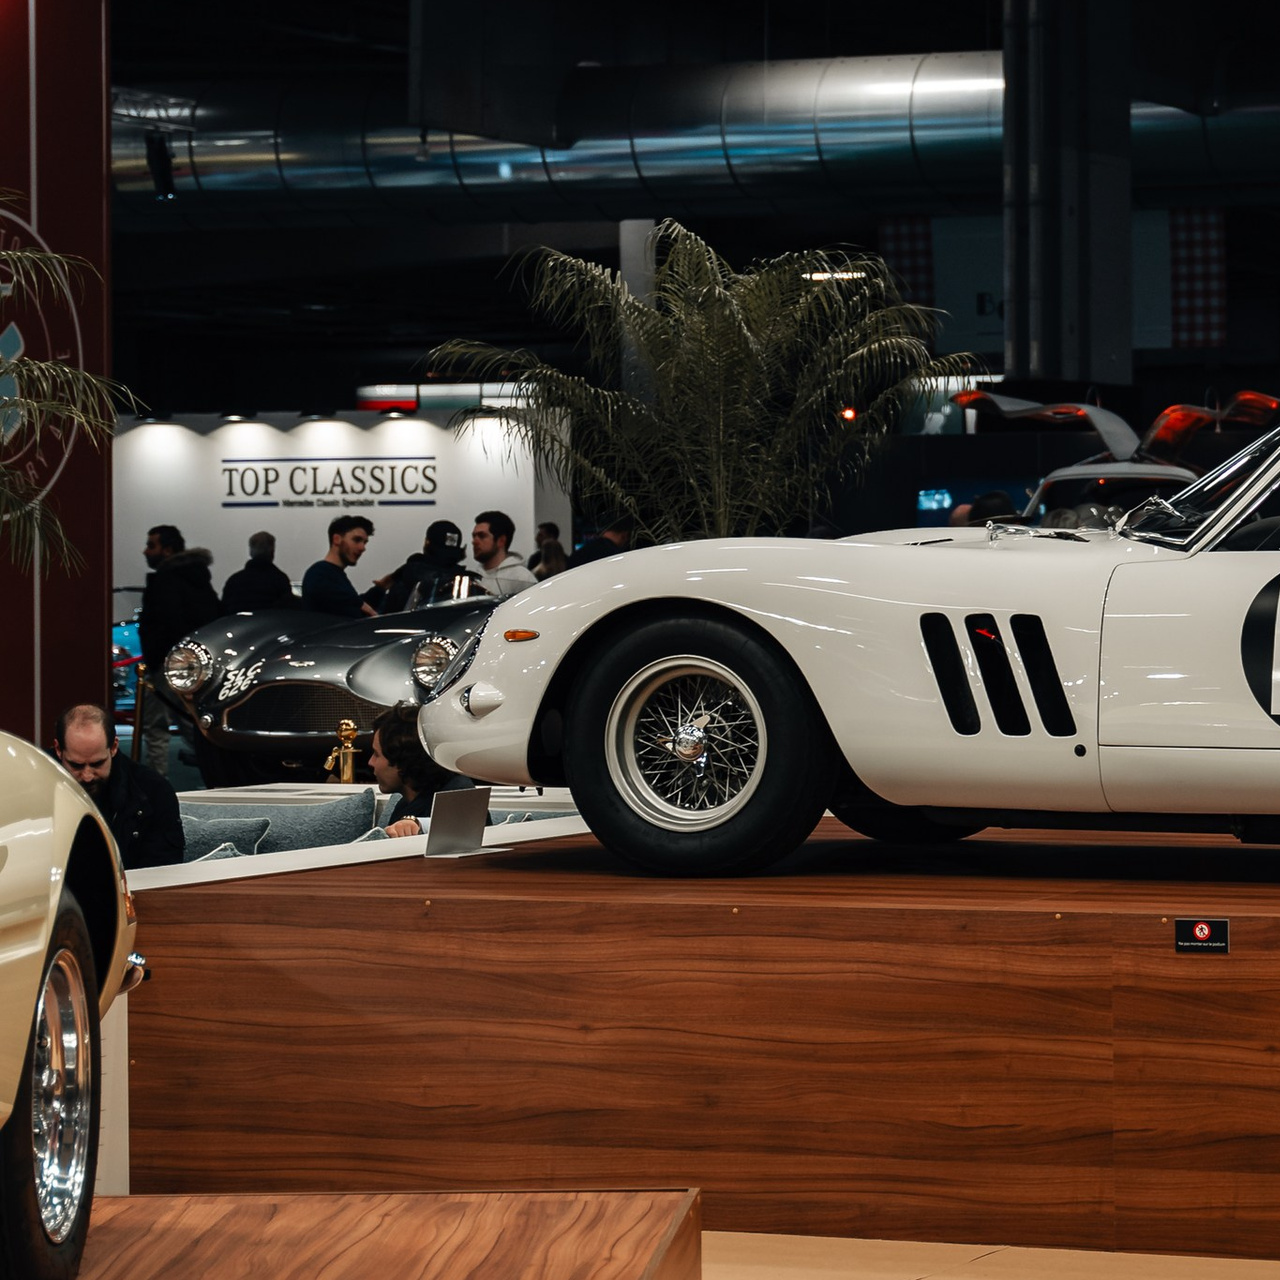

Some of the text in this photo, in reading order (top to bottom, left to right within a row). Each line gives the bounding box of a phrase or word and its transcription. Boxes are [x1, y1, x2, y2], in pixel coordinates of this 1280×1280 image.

[222, 464, 438, 496] TOP CLASSICS
[218, 675, 254, 701] 626
